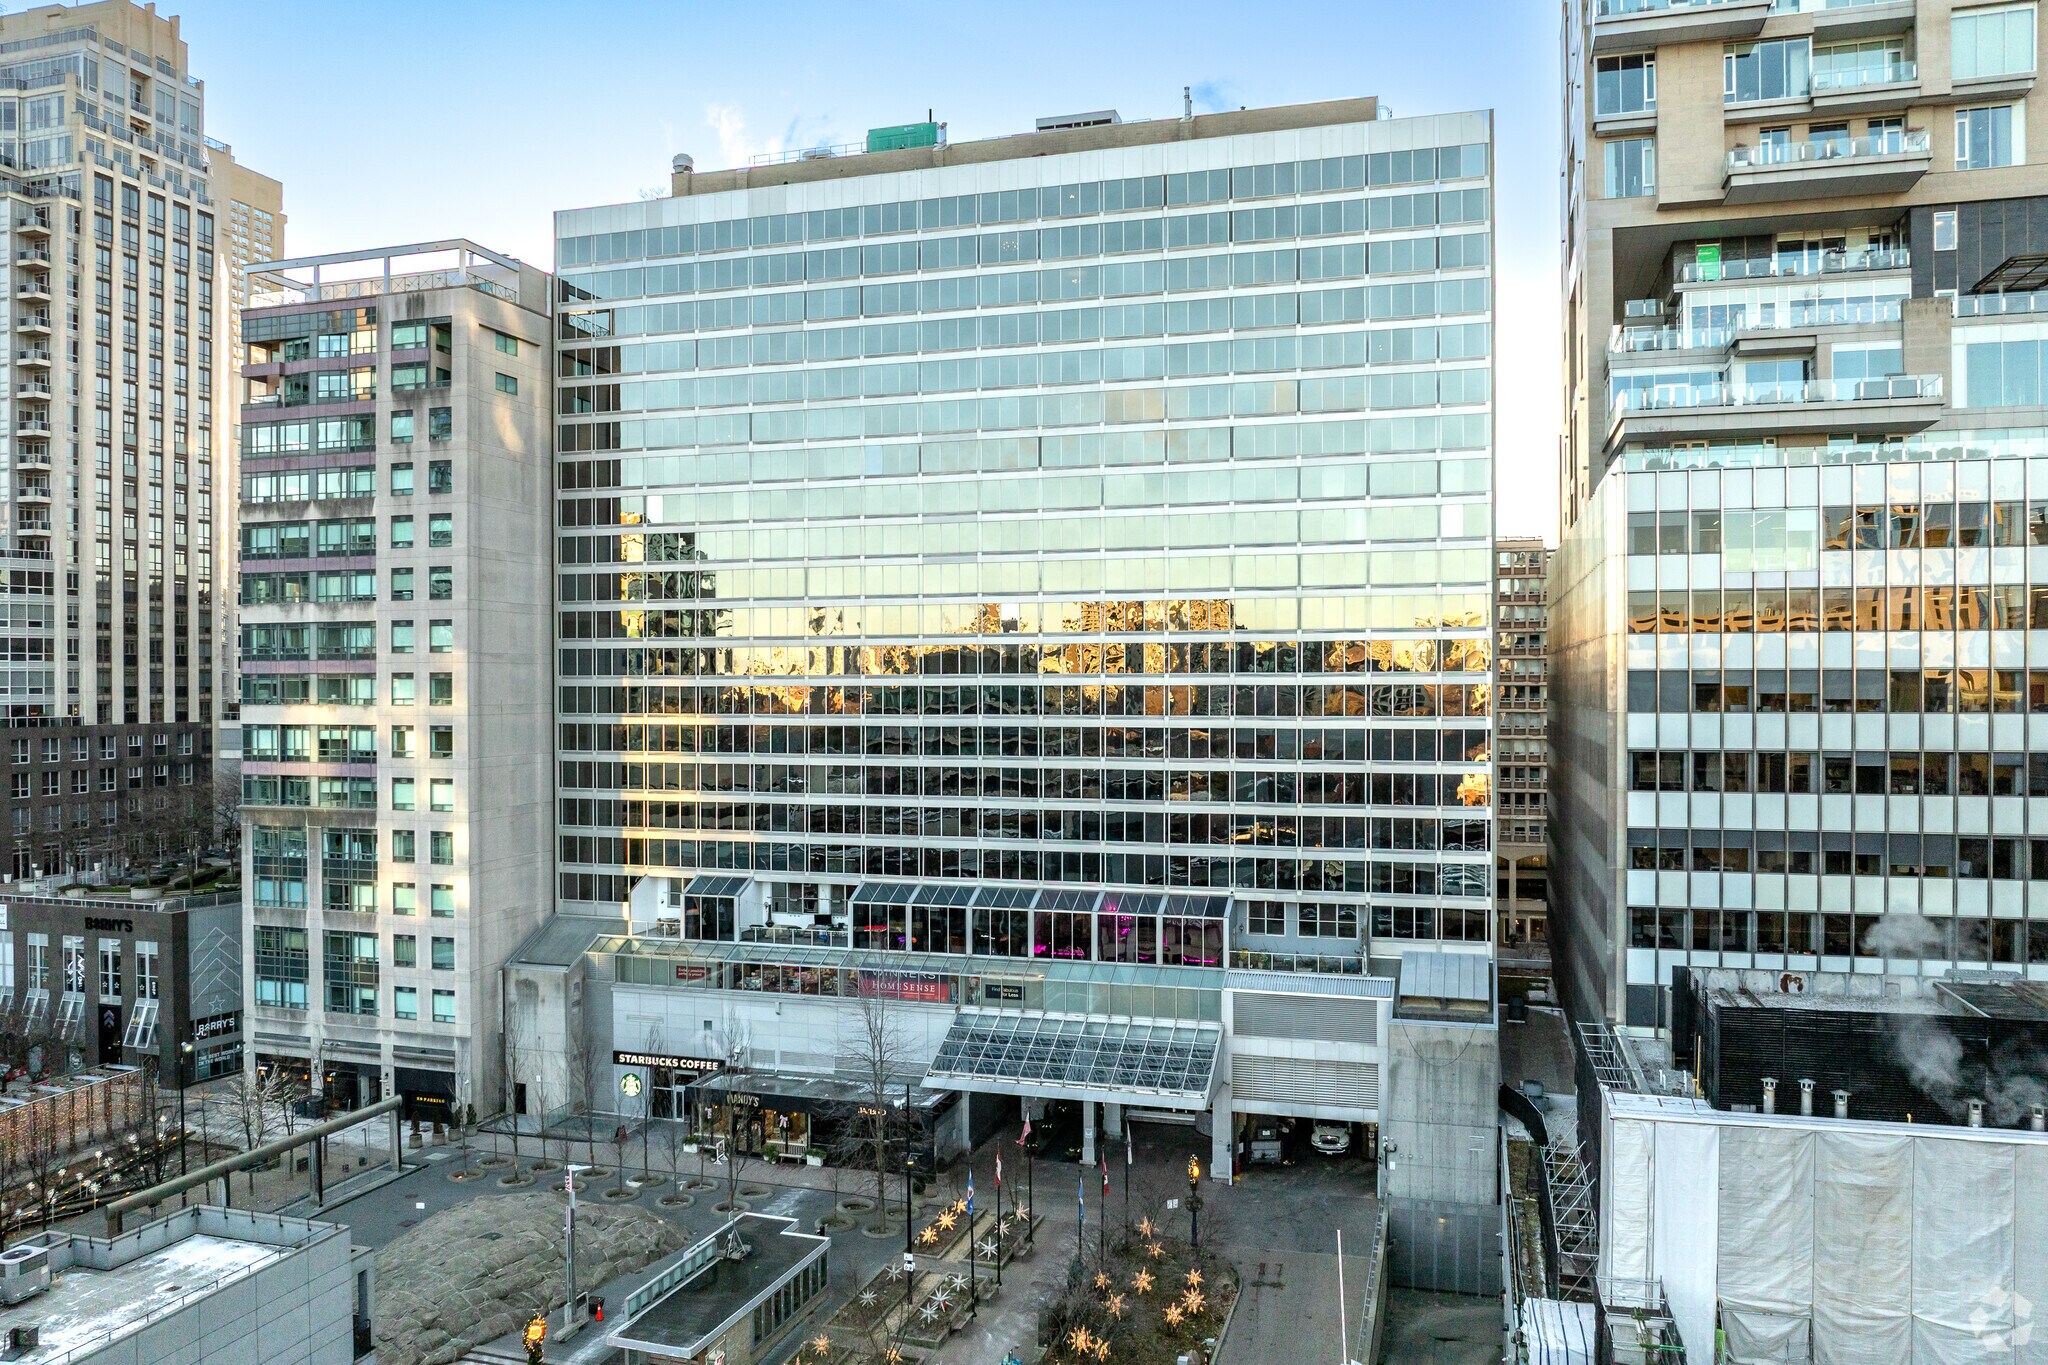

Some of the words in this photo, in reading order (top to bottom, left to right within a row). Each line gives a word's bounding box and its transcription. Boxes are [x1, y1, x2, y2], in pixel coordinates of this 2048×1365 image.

[85, 917, 133, 932] BARRY'S
[199, 1018, 235, 1032] BARRY'S
[619, 1054, 679, 1067] STARBUCKS
[680, 1059, 719, 1071] COFFEE
